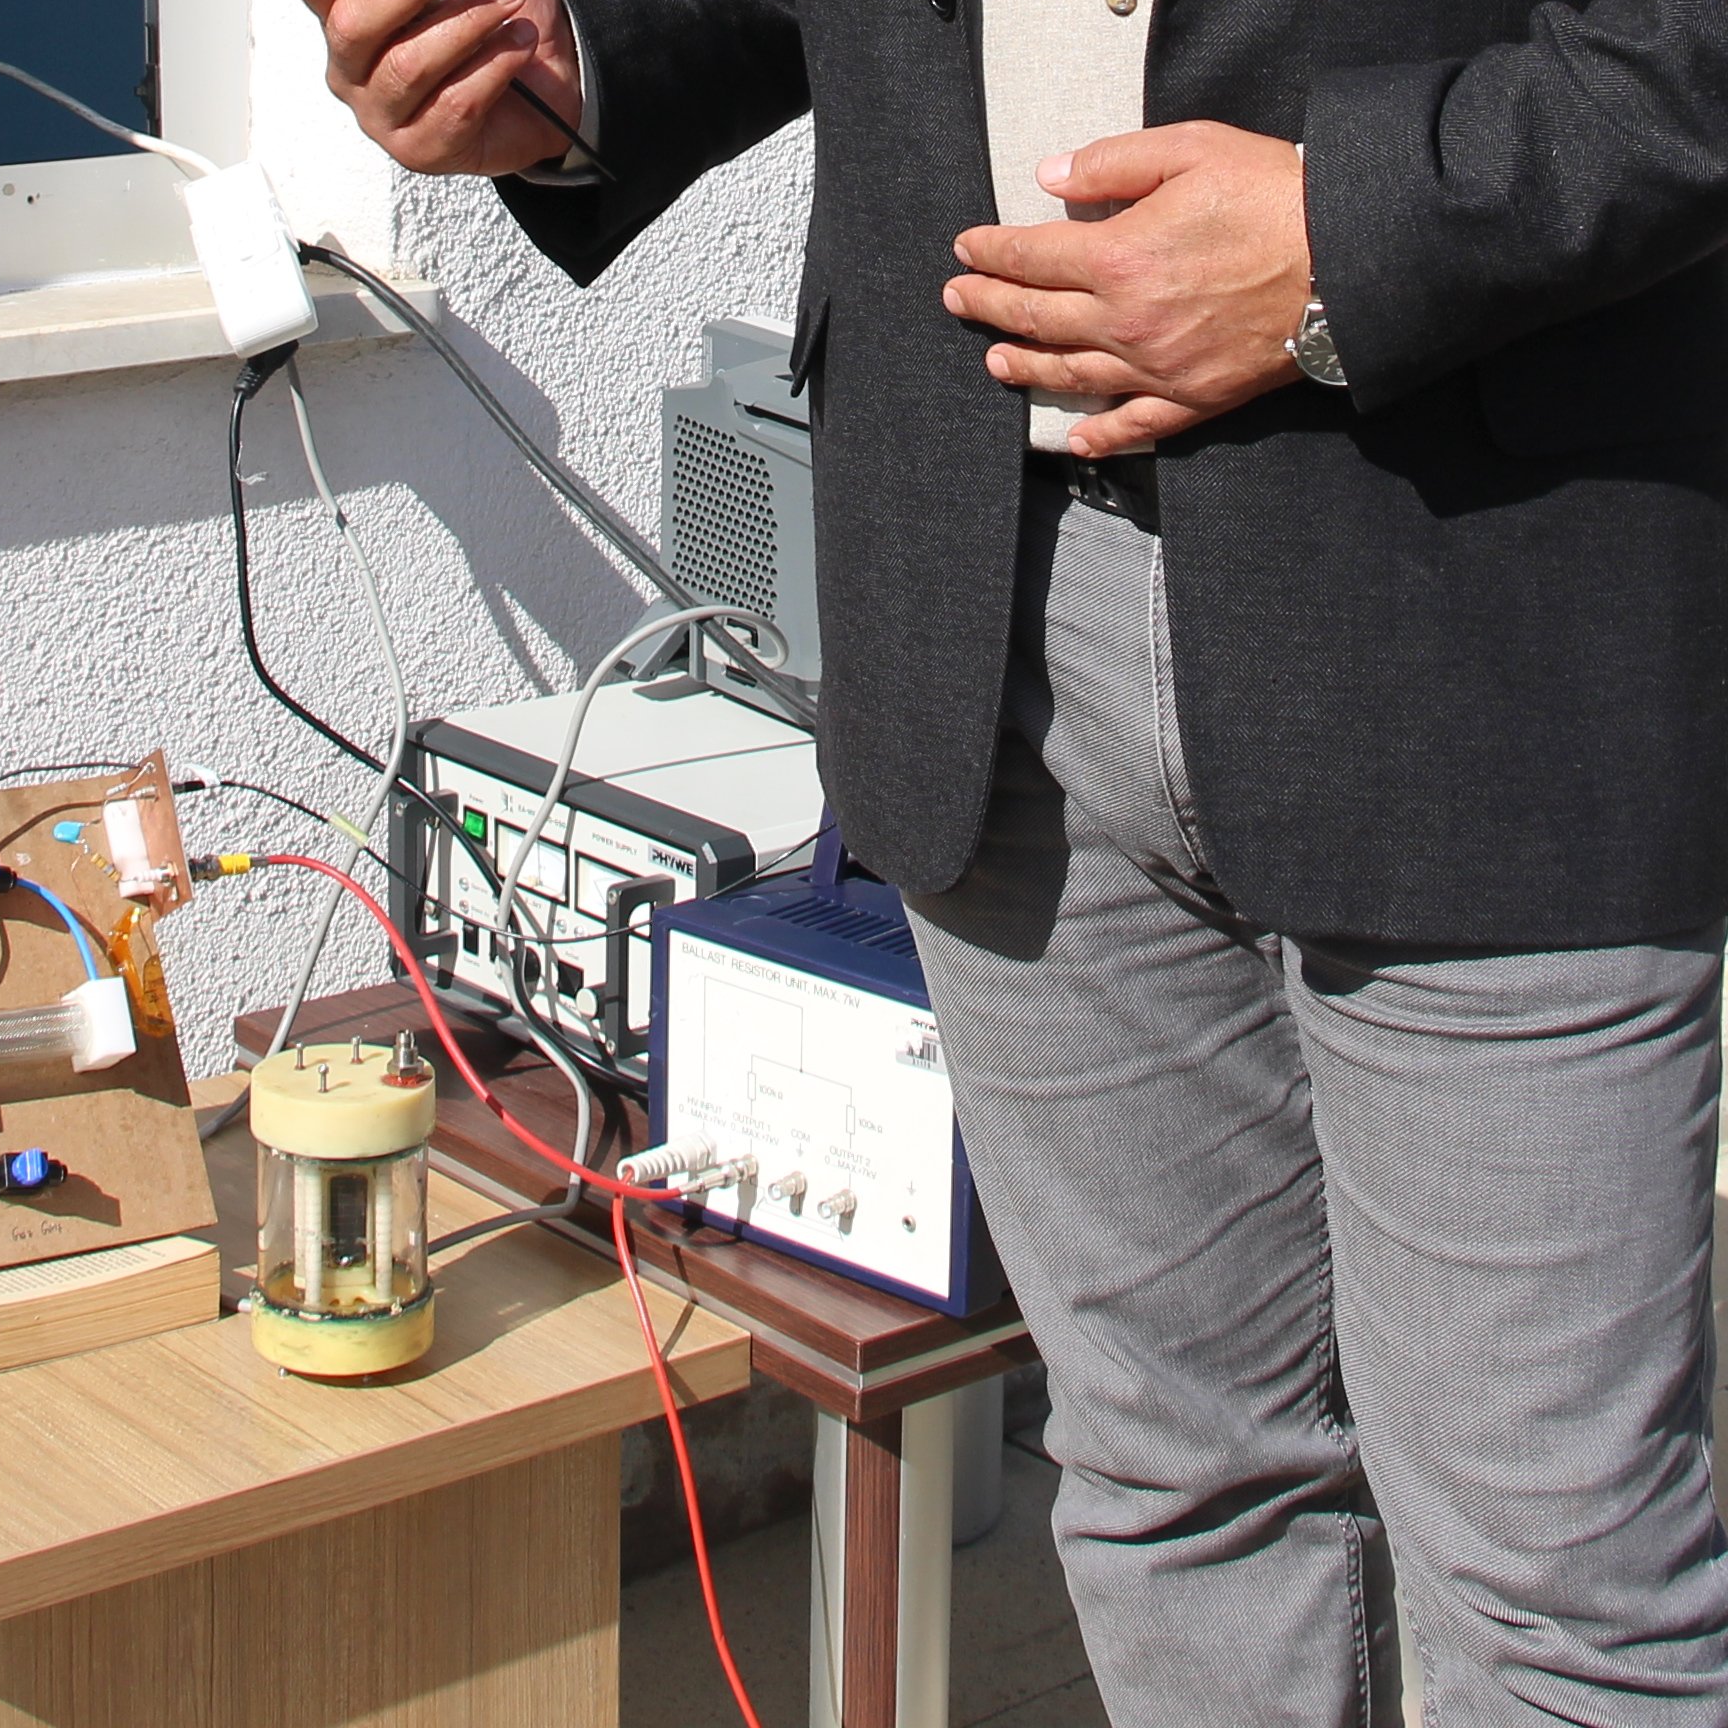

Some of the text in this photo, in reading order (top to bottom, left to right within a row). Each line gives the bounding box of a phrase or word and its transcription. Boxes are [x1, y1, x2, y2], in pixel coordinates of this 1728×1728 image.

[592, 832, 638, 856] POWER SUPPLY
[652, 848, 694, 877] PHYWE
[681, 942, 726, 966] BALLAST
[731, 959, 781, 982] RESISTOR
[843, 993, 861, 1009] 7kV
[702, 1099, 722, 1114] INPUT
[732, 1112, 765, 1131] OUTPUT
[791, 1129, 811, 1143] COM
[829, 1145, 863, 1164] OUTPUT
